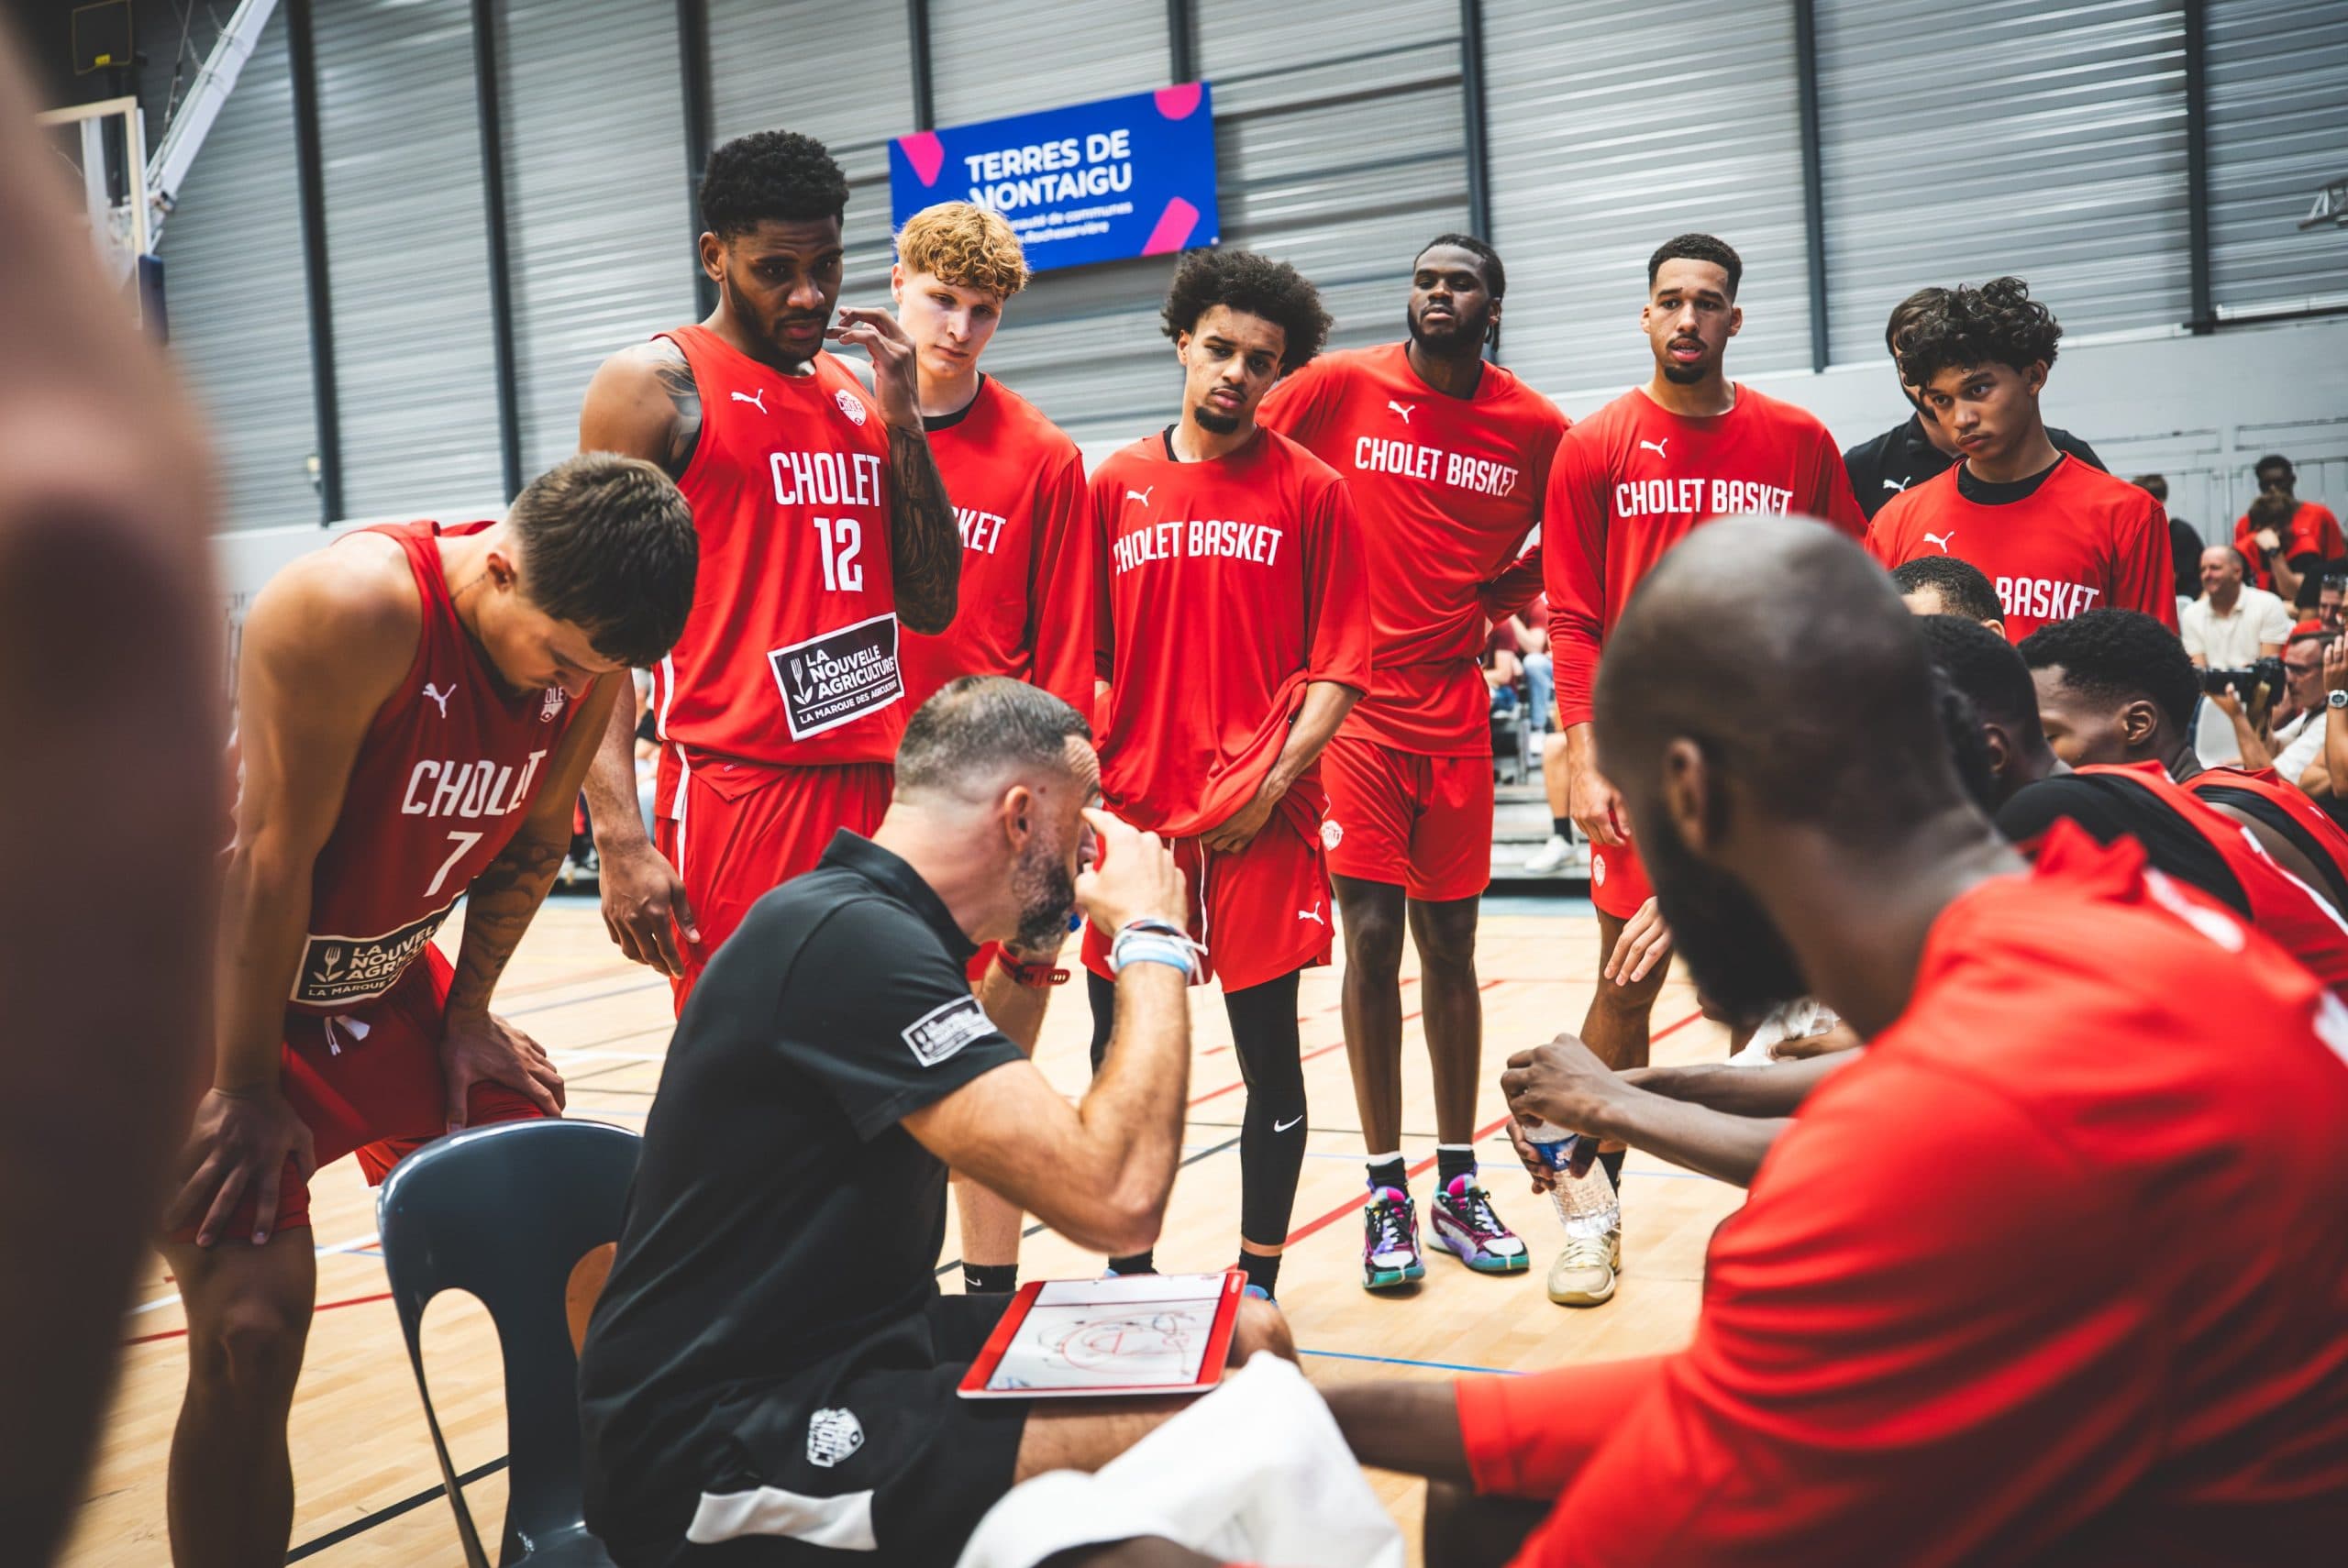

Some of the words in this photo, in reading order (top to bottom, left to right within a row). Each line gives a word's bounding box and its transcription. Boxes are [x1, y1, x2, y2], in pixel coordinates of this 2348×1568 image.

[964, 138, 1080, 183] TERRES
[1086, 128, 1131, 163] DE
[770, 452, 880, 507] CHOLET
[1355, 436, 1443, 481] CHOLET
[1445, 453, 1520, 497] BASKET
[1616, 479, 1705, 518] CHOLET
[1711, 480, 1793, 520] BASKET
[814, 517, 864, 592] 12
[1188, 520, 1283, 567] BASKET
[1995, 577, 2100, 620] BASKET
[805, 649, 830, 668] LA
[809, 645, 881, 683] NOUVELLE
[817, 656, 895, 701] AGRICULTURE
[799, 712, 814, 724] LA
[814, 699, 856, 719] MARQUE
[856, 692, 870, 705] DES
[423, 831, 483, 898] 7
[353, 944, 382, 957] LA
[308, 988, 327, 997] LA
[331, 981, 386, 996] MARQUE
